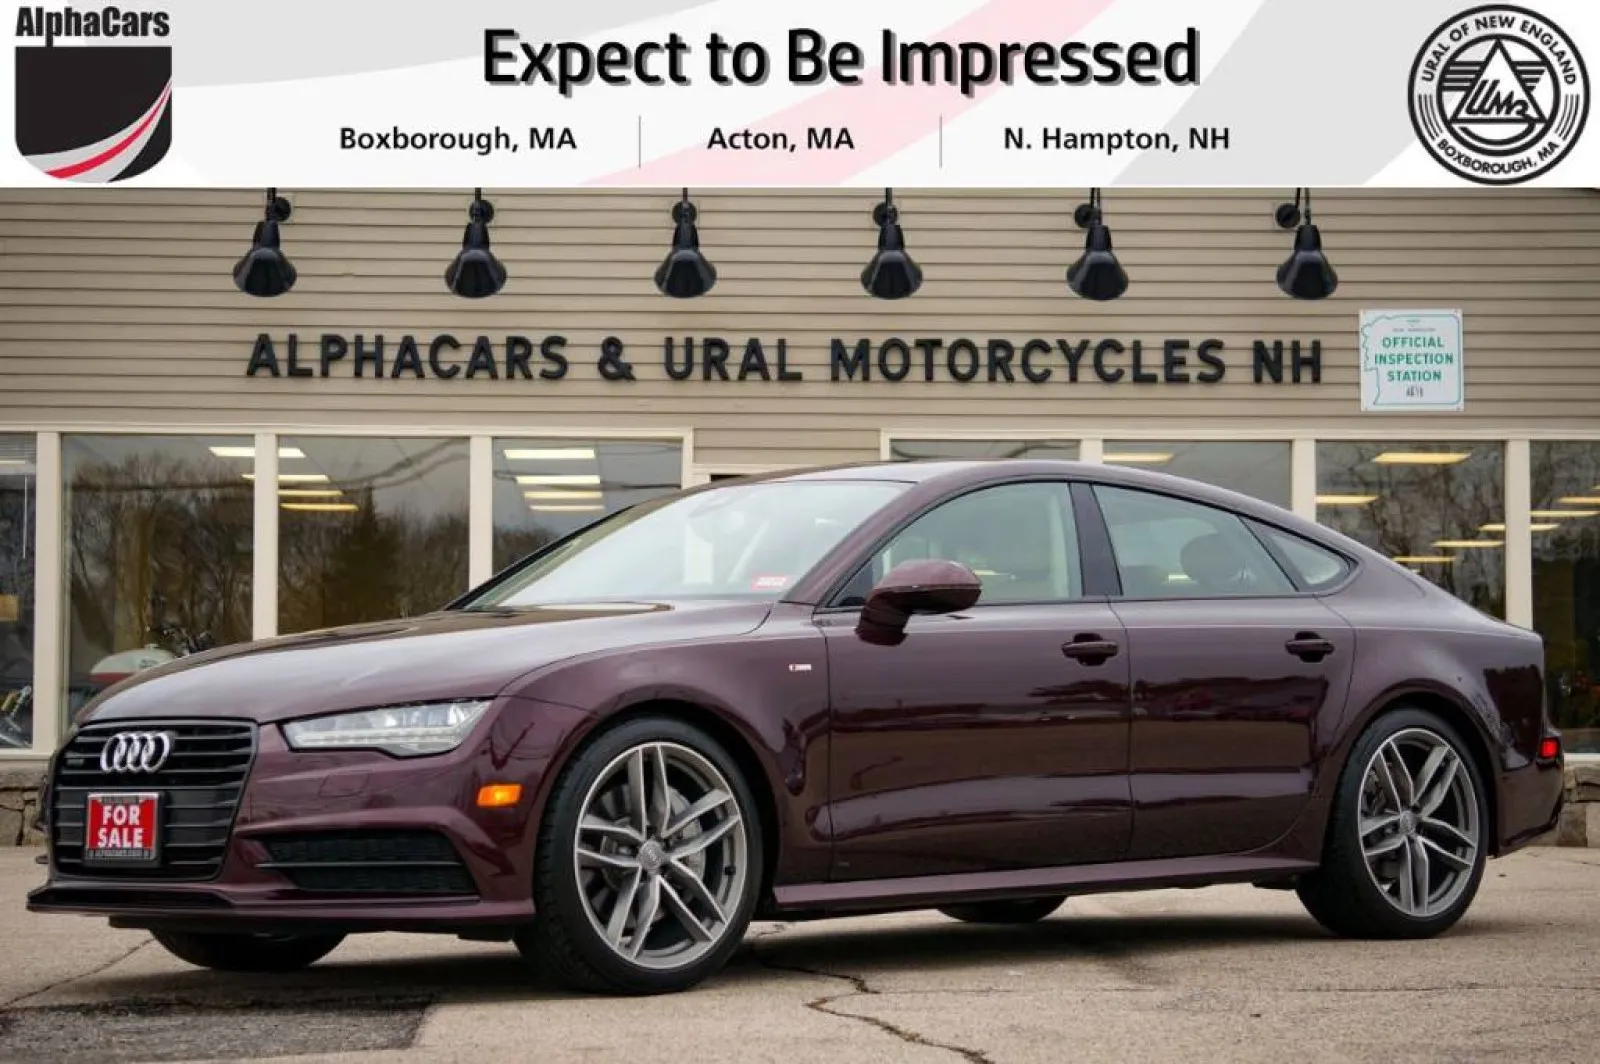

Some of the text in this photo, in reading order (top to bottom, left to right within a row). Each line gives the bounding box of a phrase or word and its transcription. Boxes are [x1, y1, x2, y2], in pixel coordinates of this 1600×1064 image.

[1382, 336, 1444, 348] OFFICIAL
[246, 333, 1322, 384] ALPHACARS & URAL MOTORCYCLES NH
[1375, 353, 1453, 365] INSPECTION
[1387, 370, 1442, 381] STATION
[102, 805, 140, 825] FOR
[97, 828, 143, 848] SALE
